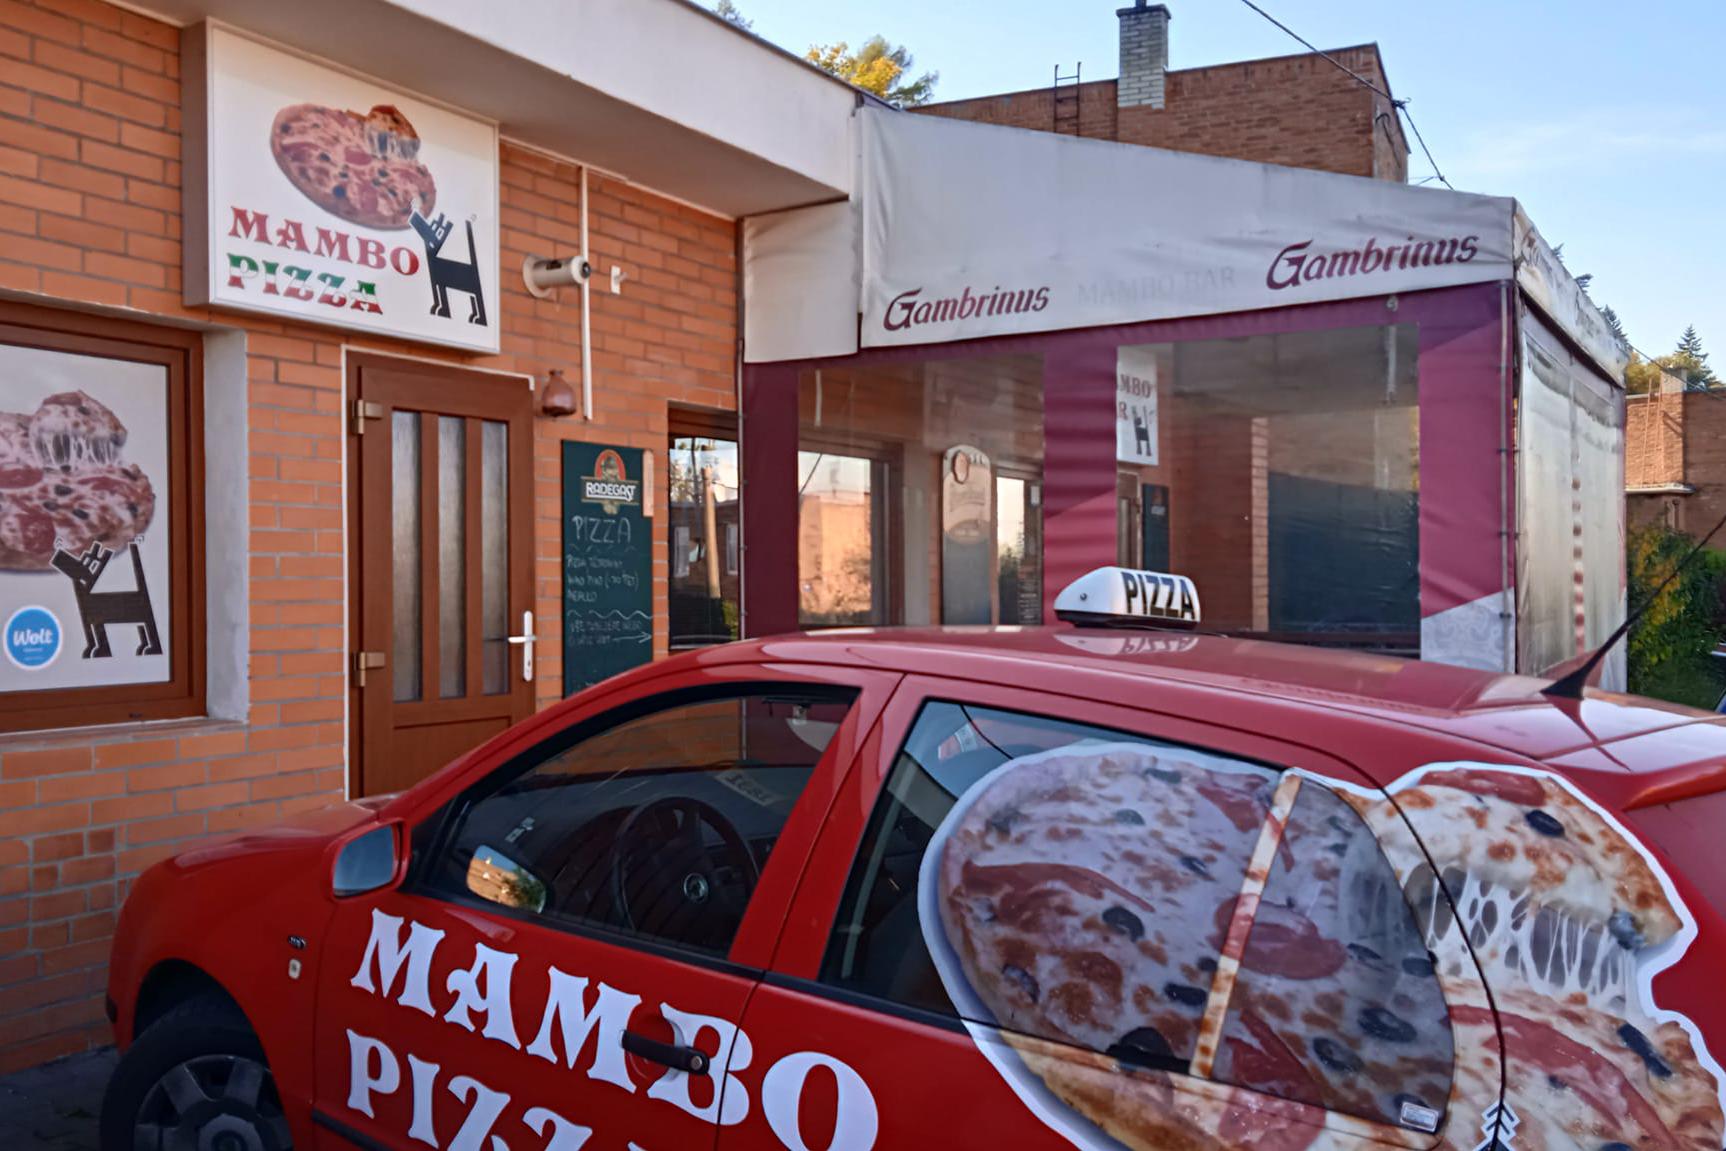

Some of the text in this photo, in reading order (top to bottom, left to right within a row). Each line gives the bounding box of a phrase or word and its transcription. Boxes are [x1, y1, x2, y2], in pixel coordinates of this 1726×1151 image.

[228, 206, 420, 276] MAMBO
[1266, 235, 1479, 290] Gambrinus
[227, 252, 383, 315] PIZZA
[883, 286, 1050, 331] Gambrinus
[586, 482, 636, 502] RADEGAST
[572, 515, 632, 543] PIZZA
[1121, 571, 1196, 620] PIZZA
[13, 628, 53, 646] Wolt
[351, 908, 879, 1151] MAMBO
